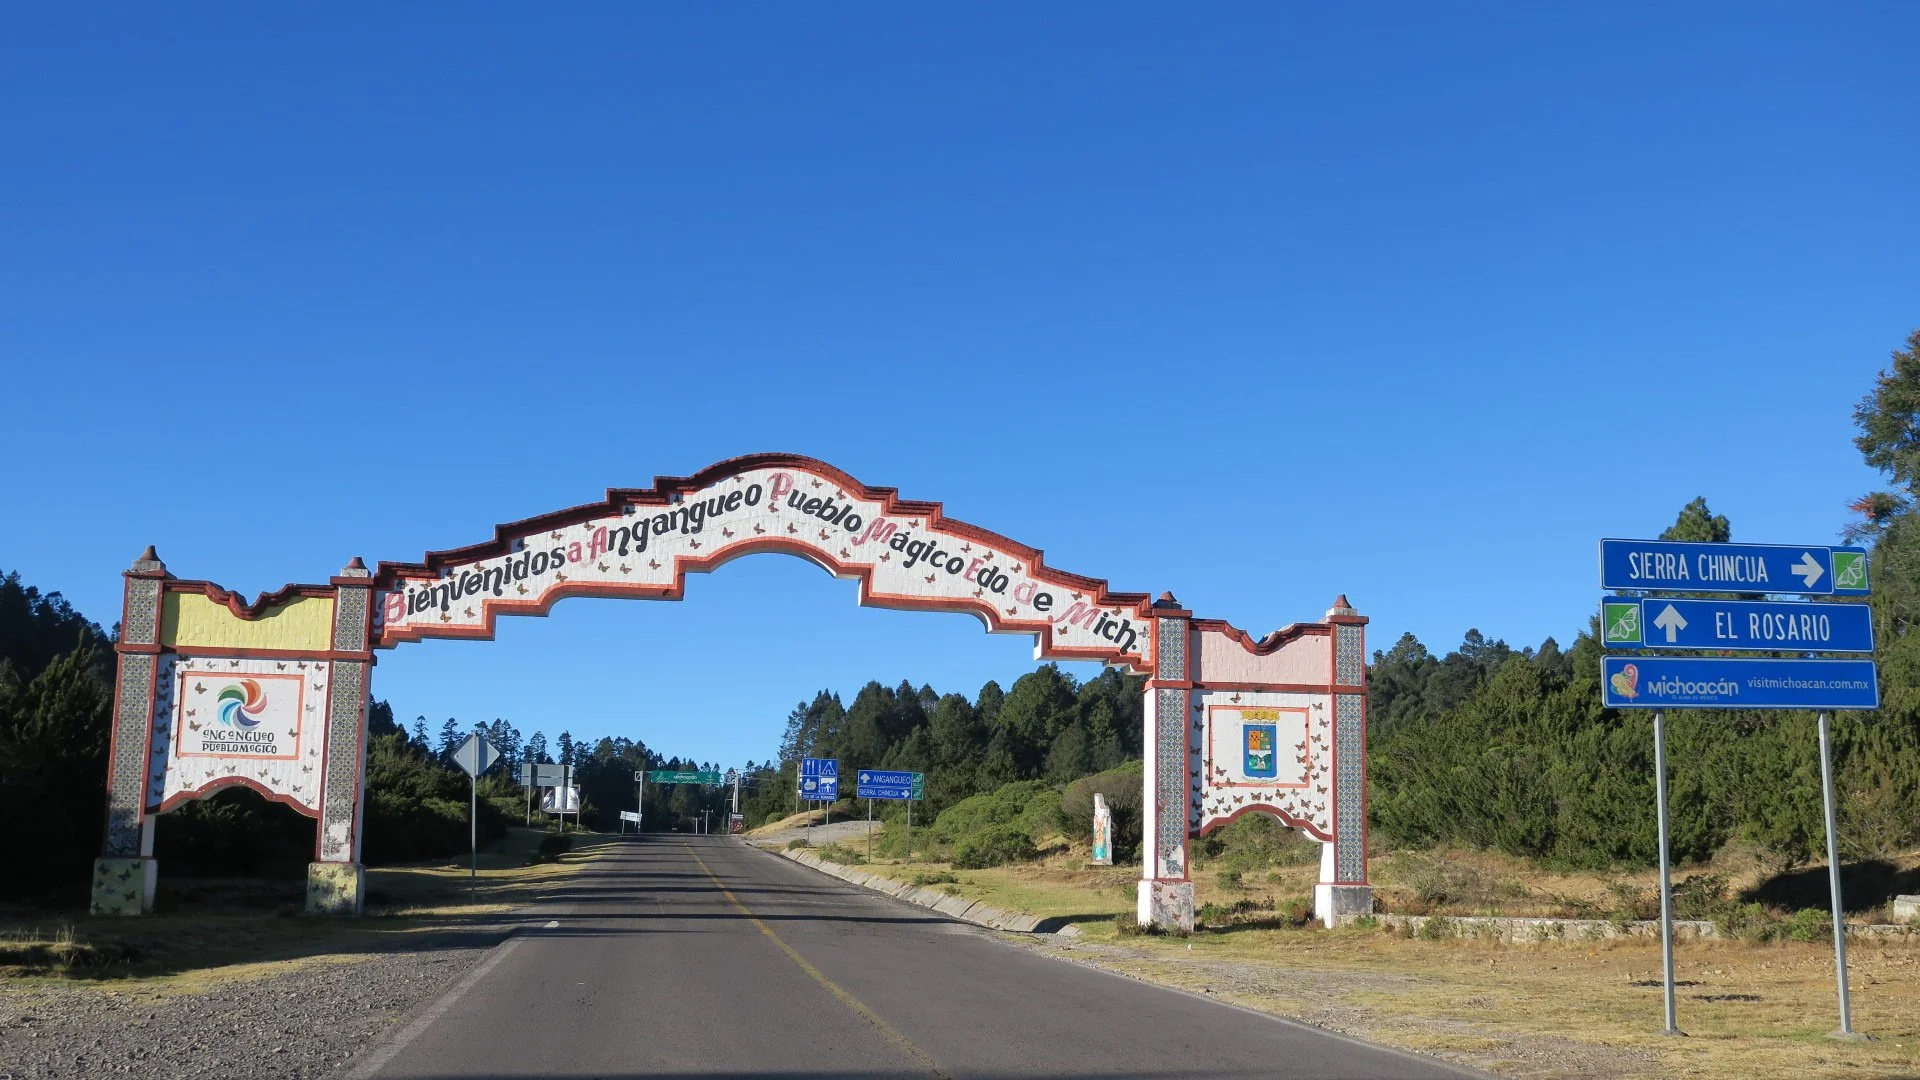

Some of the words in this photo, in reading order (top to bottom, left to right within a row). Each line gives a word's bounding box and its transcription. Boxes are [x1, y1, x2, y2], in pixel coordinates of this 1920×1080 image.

[374, 544, 566, 624] Bienvenidos
[567, 539, 582, 563] a
[585, 483, 762, 566] Angangueo
[767, 472, 862, 532] Pueblo
[852, 516, 964, 575] Mágico
[1014, 581, 1053, 612] de
[1047, 601, 1137, 655] Mich.
[1629, 552, 1690, 580] SIERRA
[1698, 553, 1769, 583] CHINCUA
[1715, 611, 1738, 639] EL
[1750, 612, 1830, 641] ROSARIO
[1648, 675, 1739, 697] Michoacán
[1747, 677, 1869, 690] visitmichoacan.com.mx
